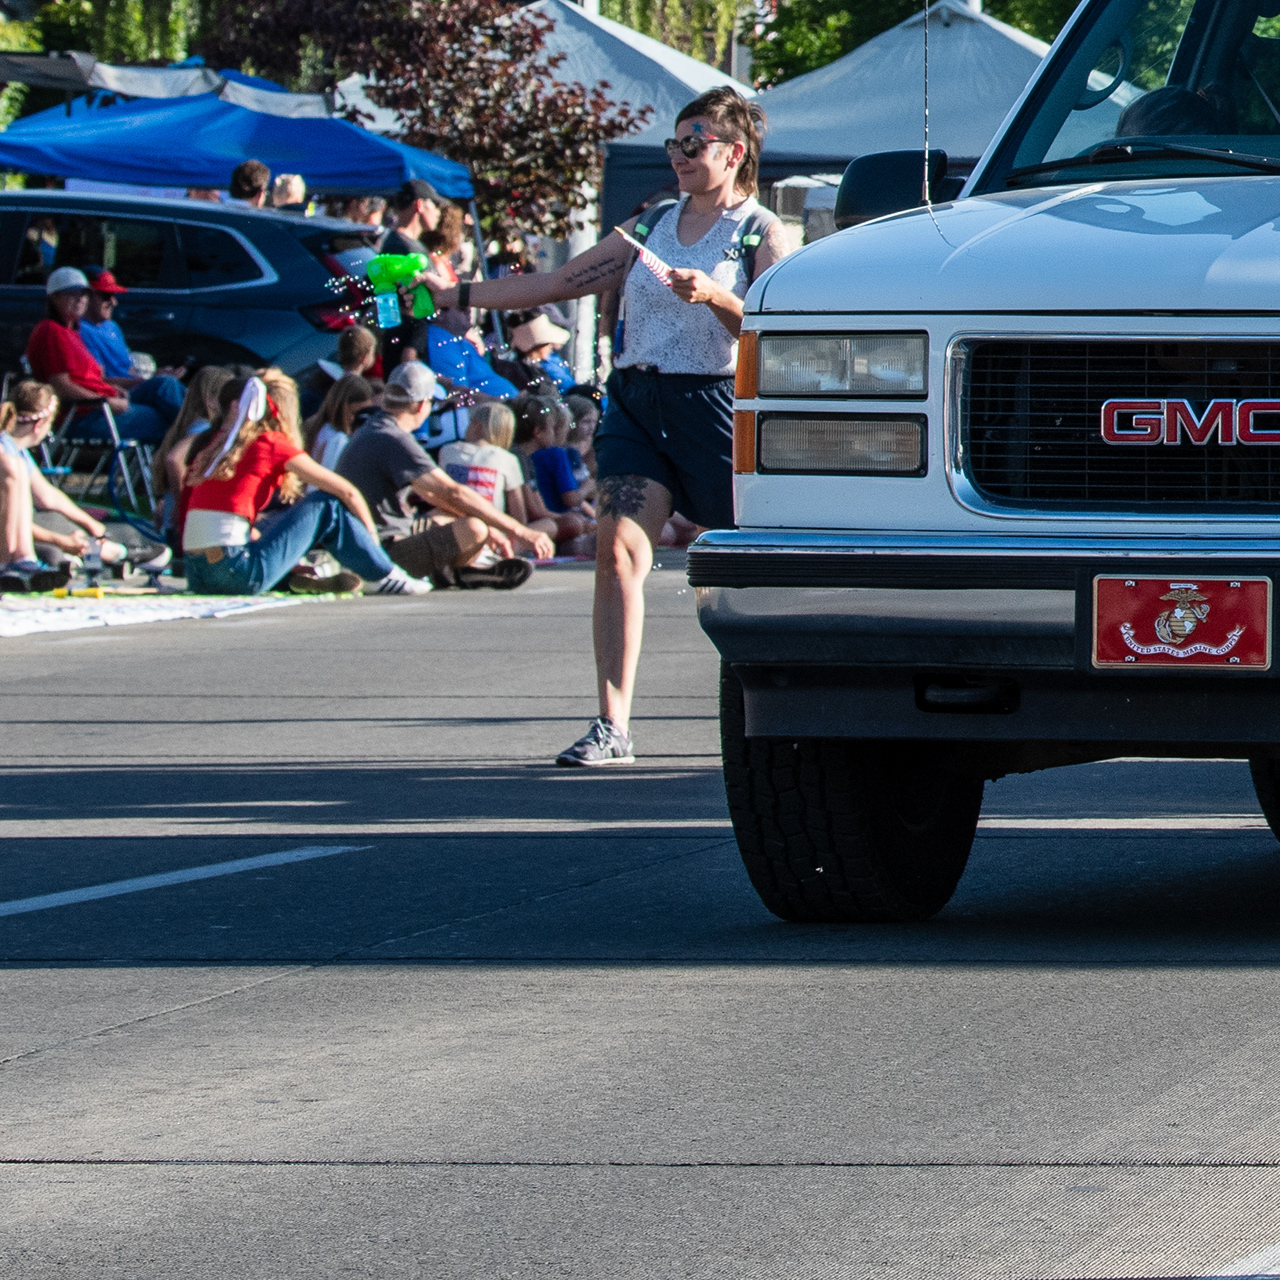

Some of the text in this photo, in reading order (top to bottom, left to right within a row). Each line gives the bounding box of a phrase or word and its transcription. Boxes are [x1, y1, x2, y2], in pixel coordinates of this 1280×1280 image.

[1125, 636, 1238, 657] UNITED STATES MARINE CORPS
